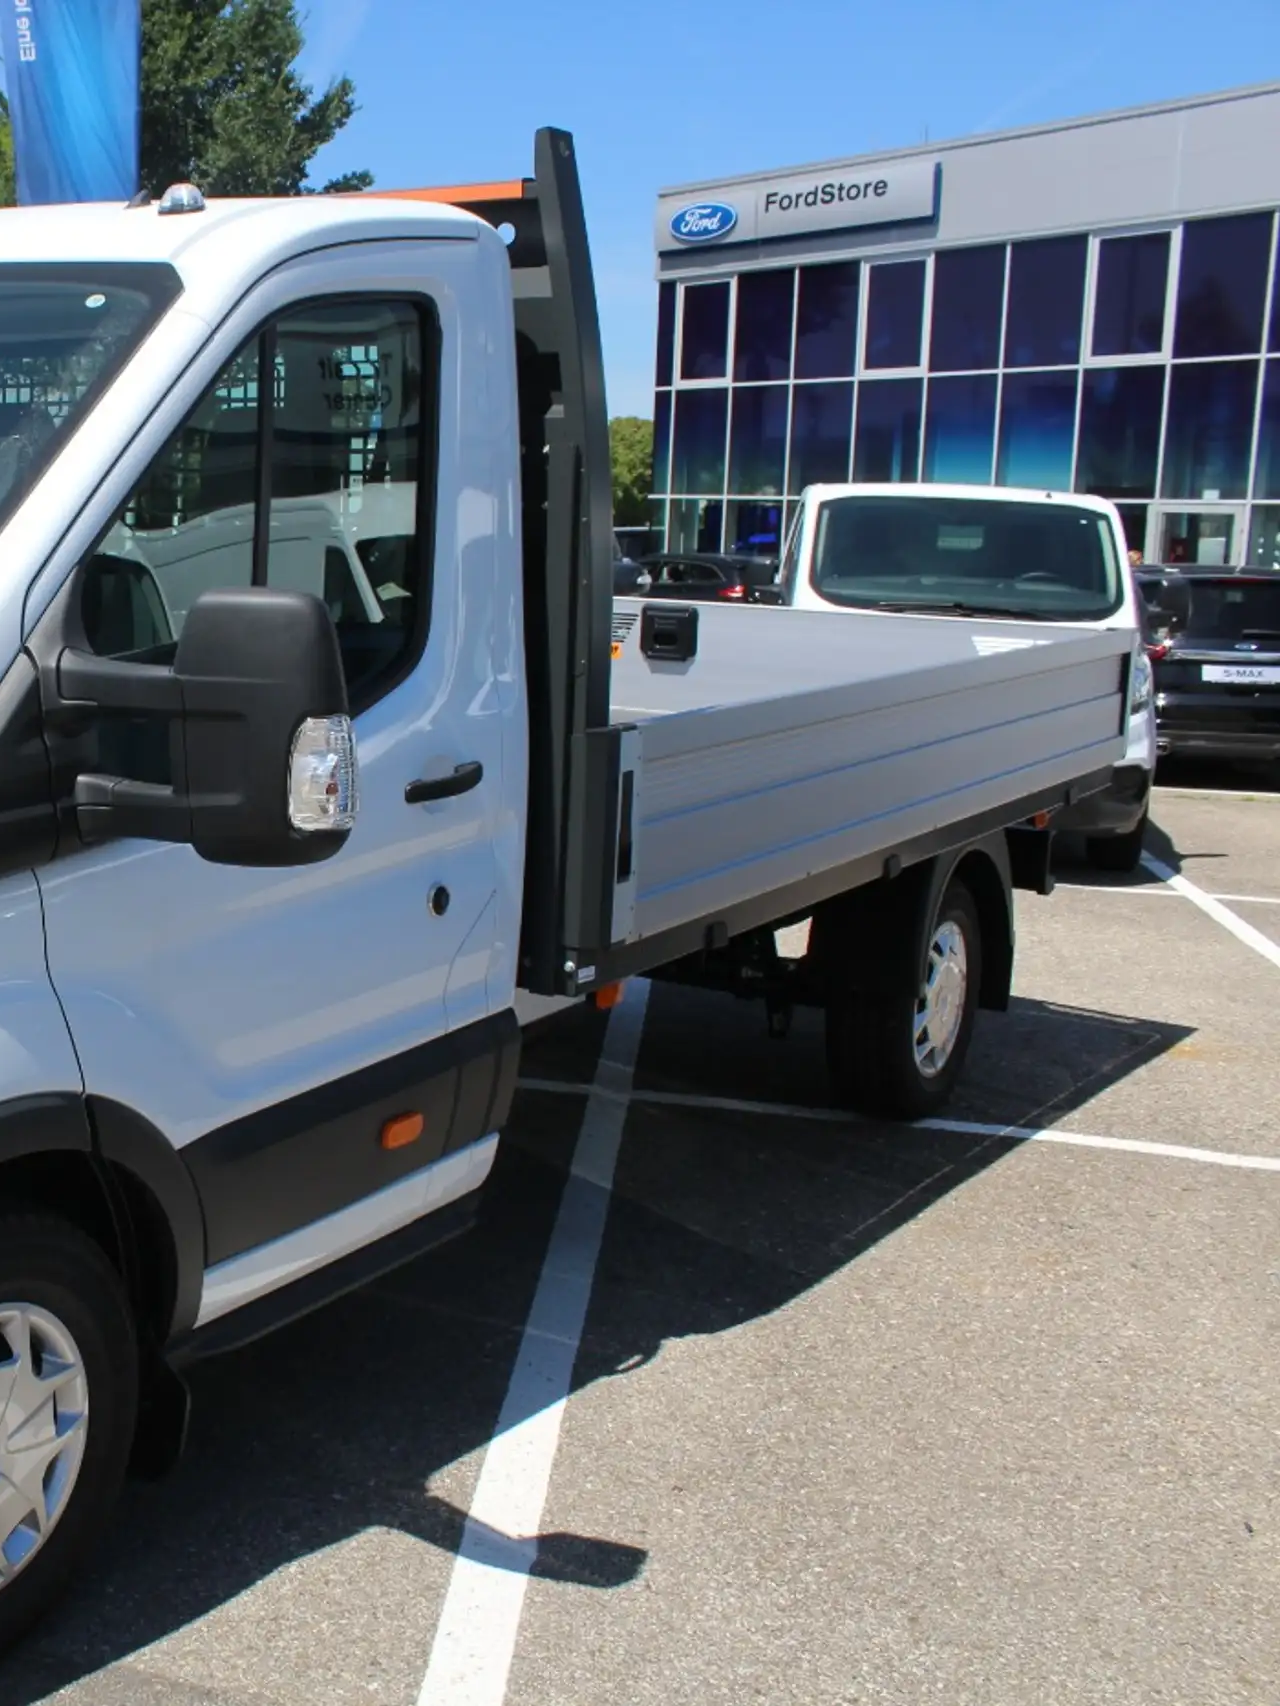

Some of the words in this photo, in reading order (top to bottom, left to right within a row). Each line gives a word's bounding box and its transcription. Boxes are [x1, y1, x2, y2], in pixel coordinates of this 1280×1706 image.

[764, 177, 889, 214] FordStore
[678, 207, 723, 234] Ford
[1223, 669, 1265, 679] S-MAX
